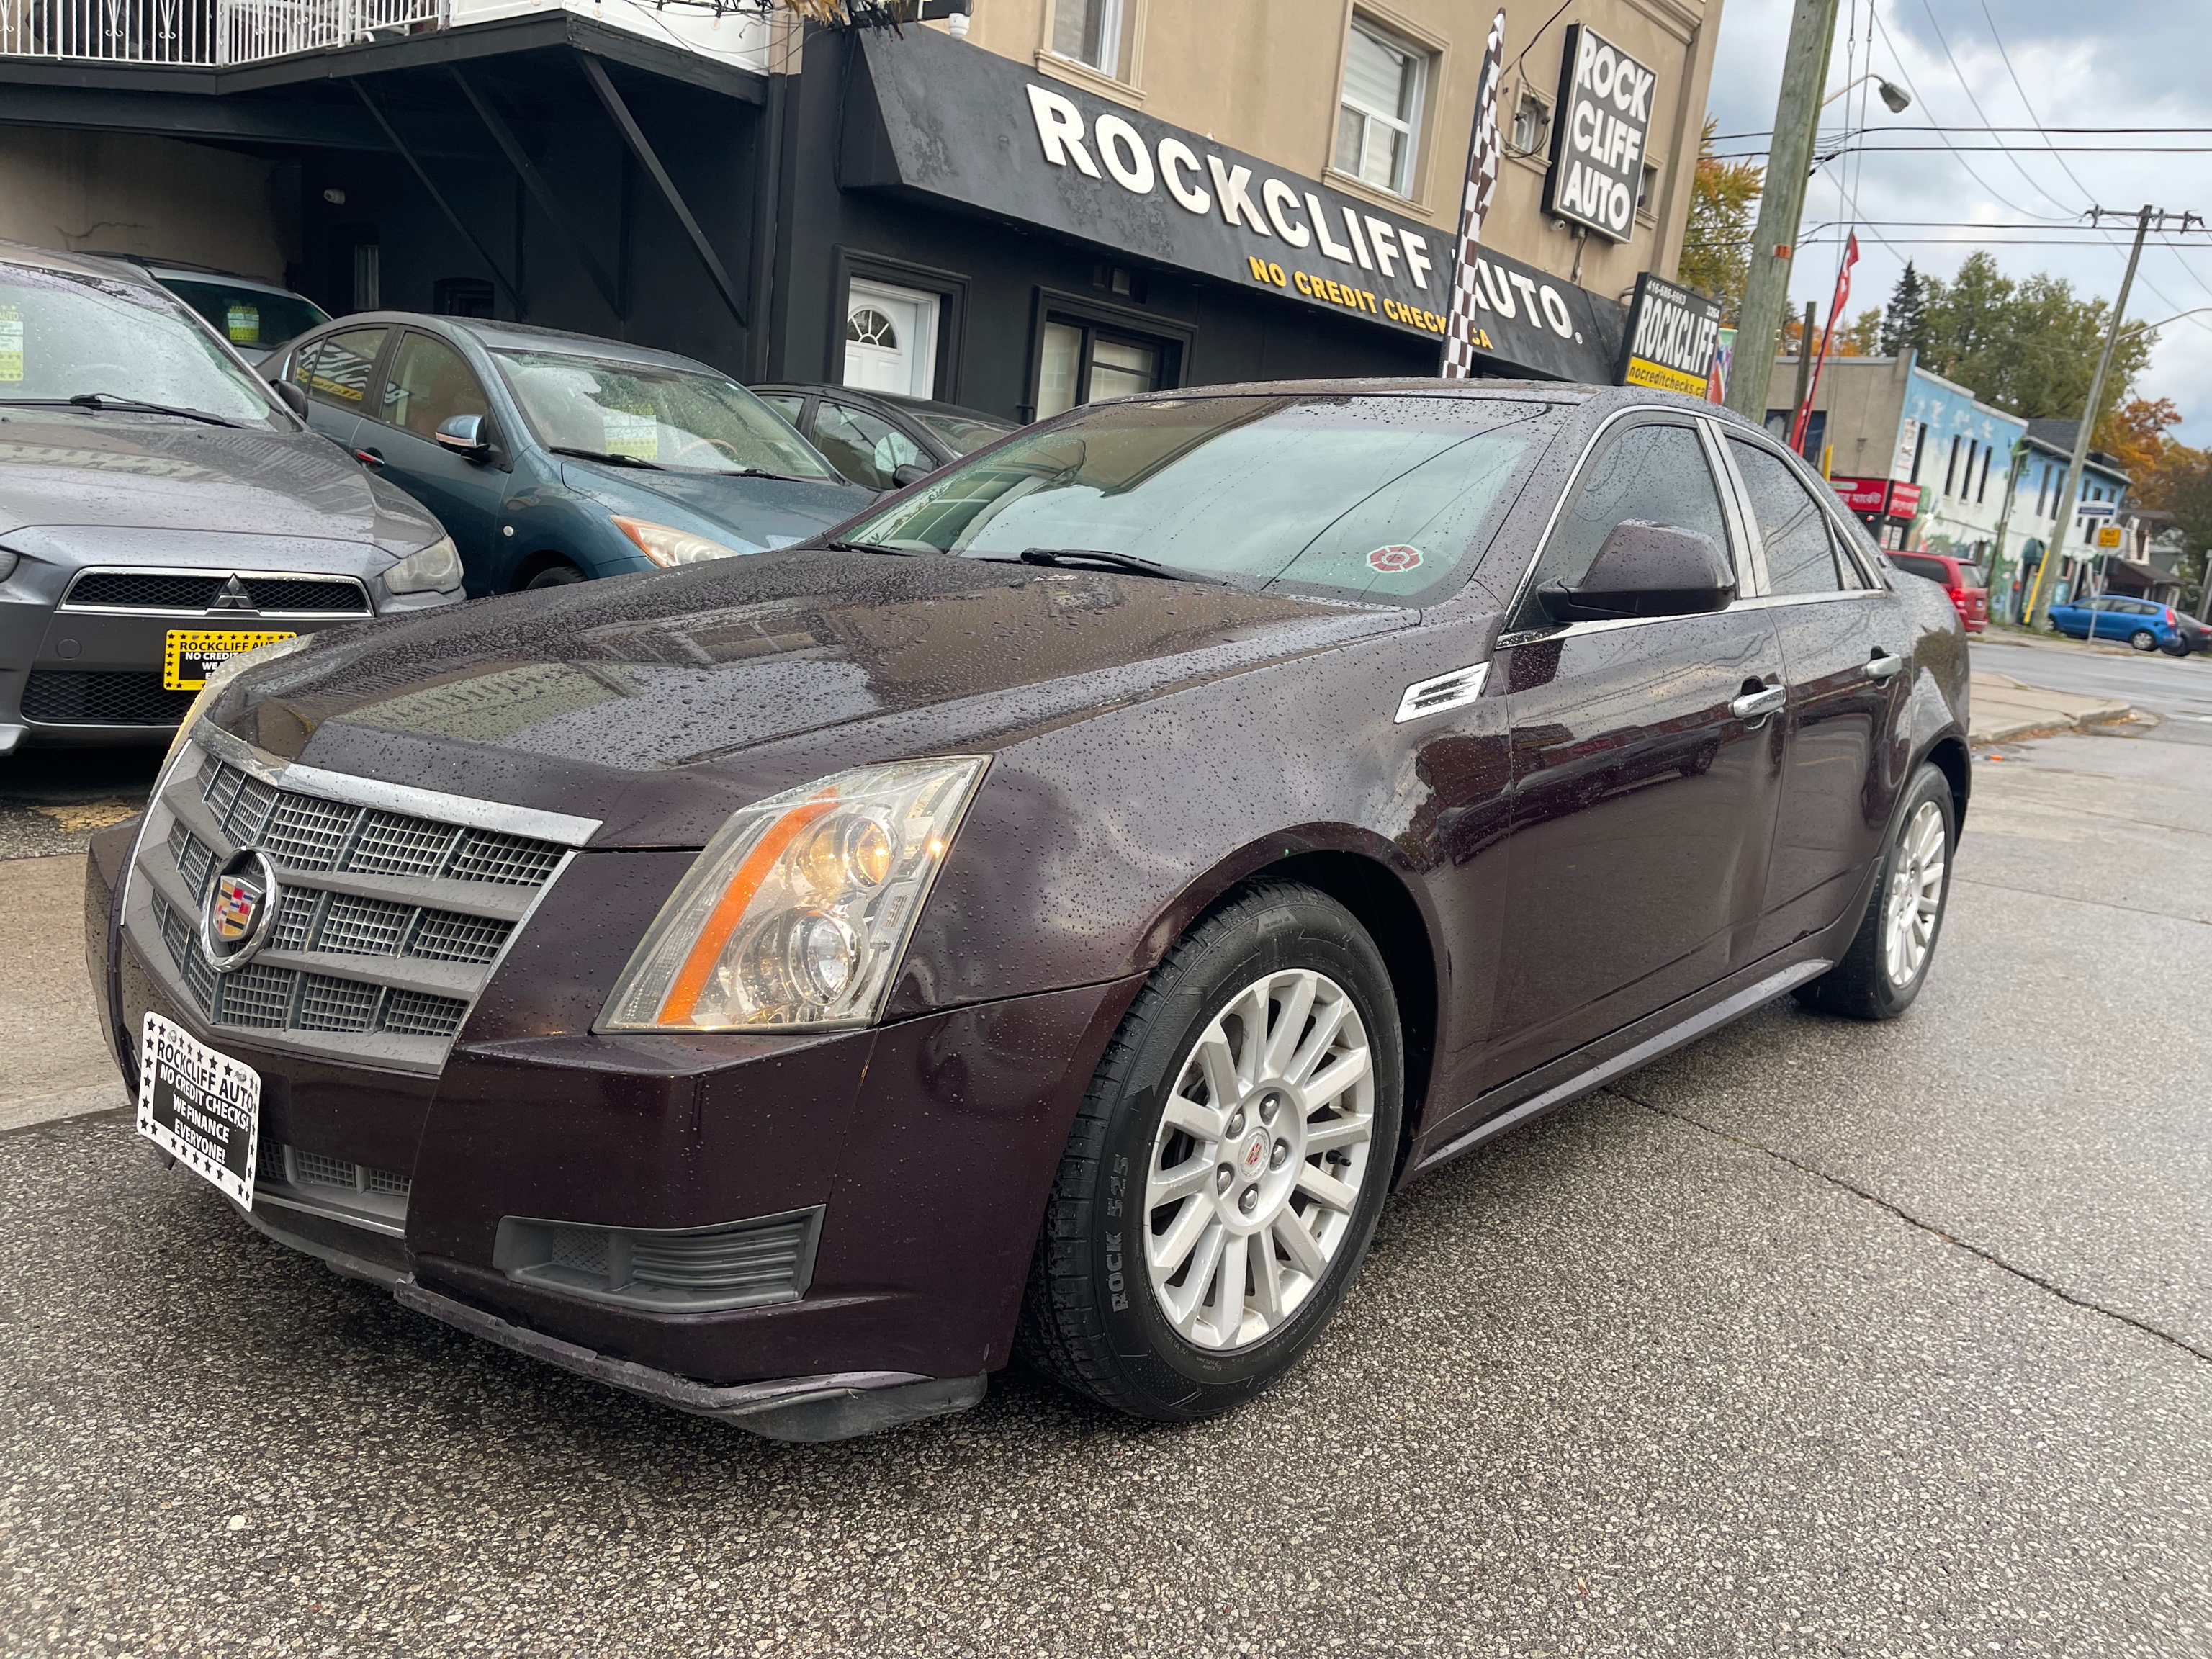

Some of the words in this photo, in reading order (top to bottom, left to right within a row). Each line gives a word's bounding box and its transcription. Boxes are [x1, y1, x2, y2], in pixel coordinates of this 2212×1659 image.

[1577, 31, 1655, 123] ROCK
[1573, 99, 1642, 175] CLIFF
[1026, 83, 1432, 289] ROCKCLIFF
[1563, 160, 1631, 231] AUTO
[1249, 256, 1287, 287] NO
[1294, 270, 1378, 314] CREDIT
[1632, 294, 1718, 376] ROCKCLIFF
[1629, 365, 1705, 397] nocreditchecks.ca
[180, 642, 248, 651] ROCKCLIFF
[202, 662, 217, 670] WE
[157, 1038, 216, 1091] ROCKCLIFF
[218, 1078, 253, 1113] AUTO
[160, 1063, 175, 1084] NO
[175, 1074, 205, 1107] CREDIT
[205, 1094, 250, 1133] CHECKS!
[173, 1092, 186, 1117] WE
[187, 1108, 230, 1143] FINANCE
[174, 1118, 227, 1165] EVERYONE!
[1107, 1153, 1129, 1218] 525
[1105, 1231, 1129, 1312] ROCK
